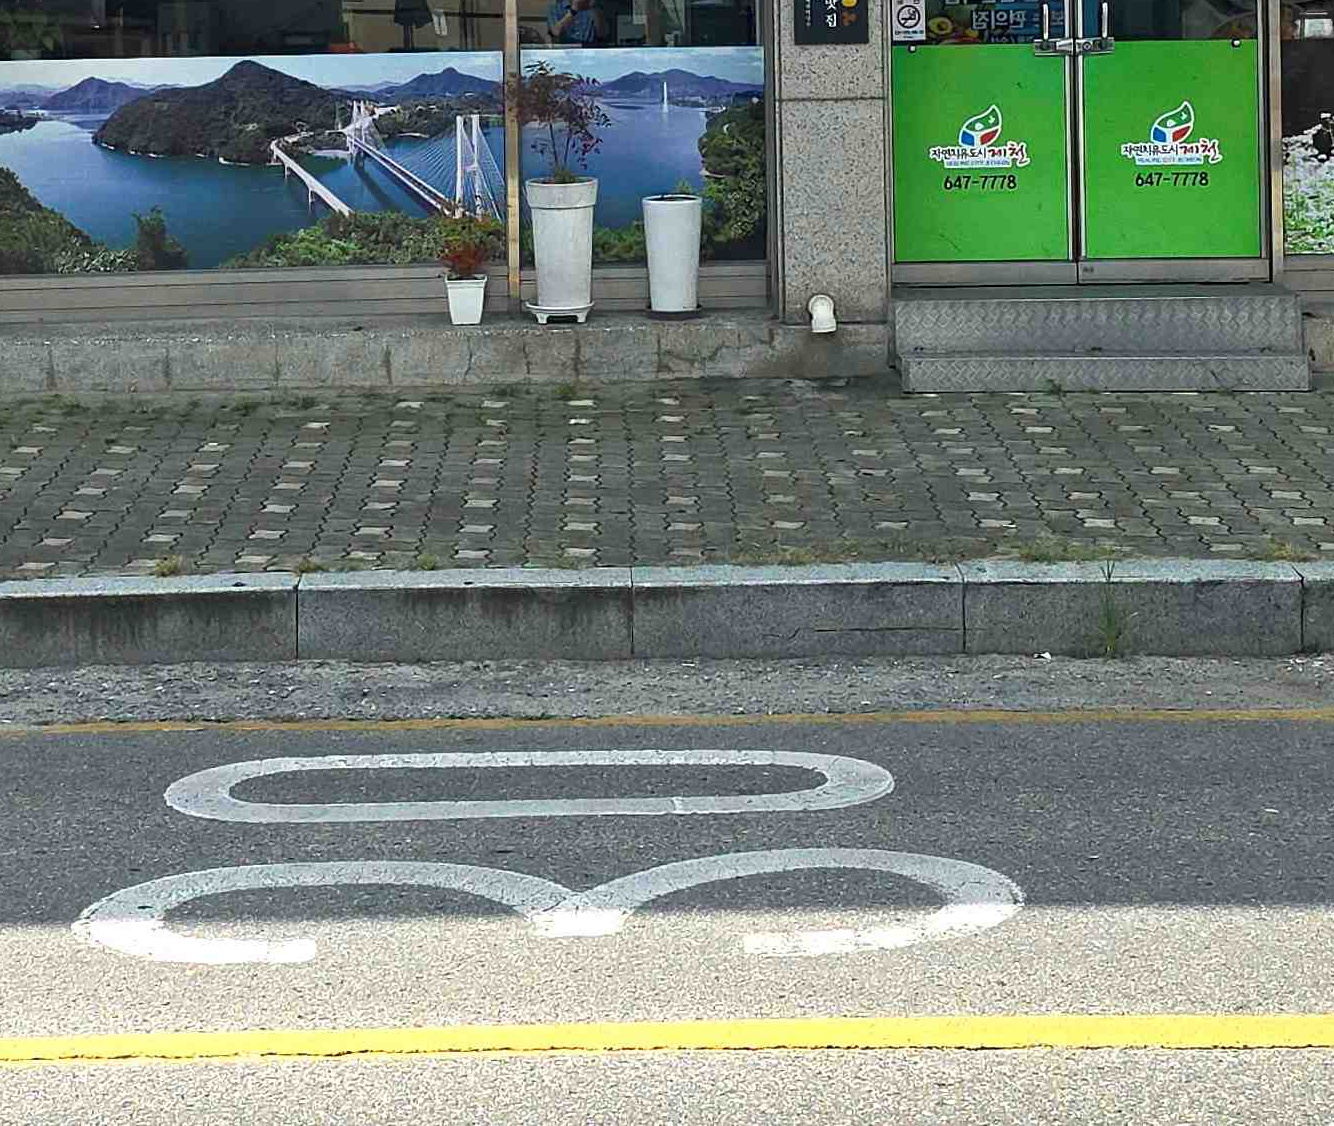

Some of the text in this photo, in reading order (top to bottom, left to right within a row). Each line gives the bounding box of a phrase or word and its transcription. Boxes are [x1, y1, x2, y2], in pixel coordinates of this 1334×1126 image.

[931, 148, 986, 159] 자연치유도시
[988, 144, 1029, 163] 제천
[1123, 144, 1178, 156] 자연치유도시
[1179, 140, 1221, 161] 제천
[944, 174, 1017, 190] 647-7778
[1135, 172, 1209, 186] 647-7778
[70, 749, 1025, 964] 30
